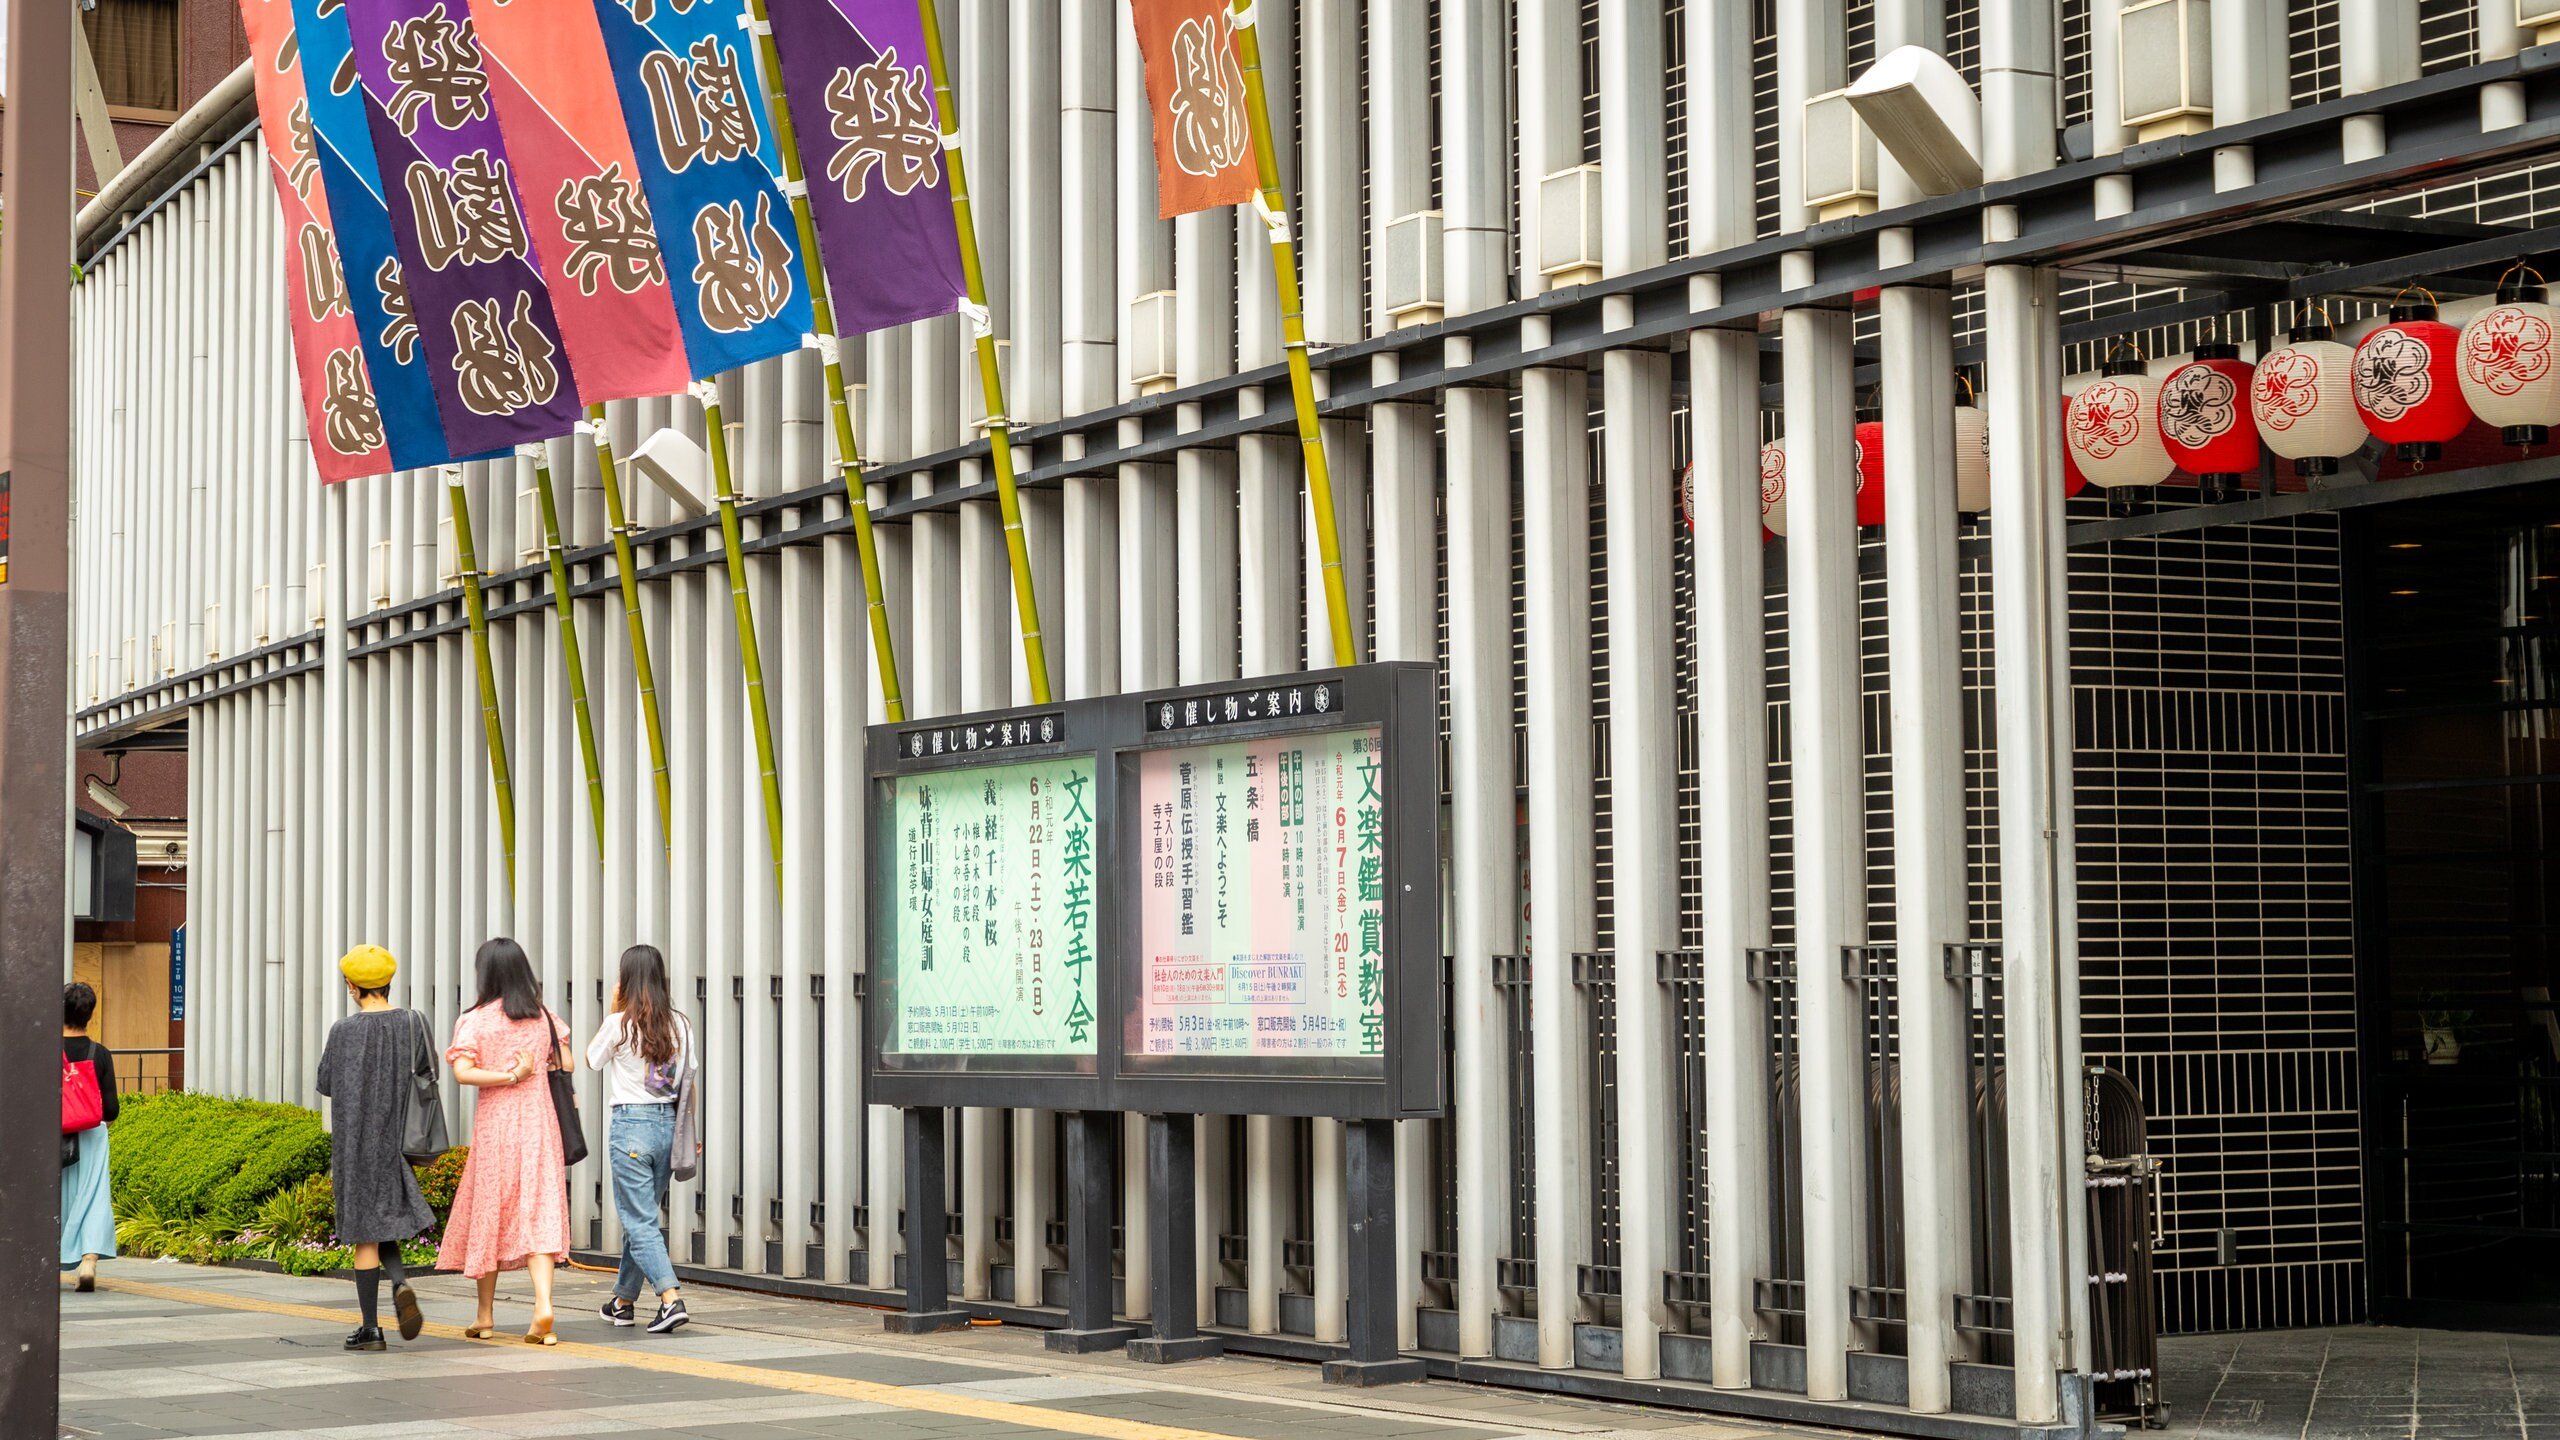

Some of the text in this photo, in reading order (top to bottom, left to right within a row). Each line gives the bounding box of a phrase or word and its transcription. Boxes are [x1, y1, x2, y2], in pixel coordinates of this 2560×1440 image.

[931, 719, 1032, 755] 催し物ご案内
[1184, 690, 1303, 726] 催し物ご案内
[1043, 777, 1054, 845] 令和元年
[1245, 754, 1259, 843] 五条橋
[918, 784, 934, 973] 妹背山婦女庭訓
[953, 824, 961, 923] すしやの段
[983, 778, 998, 947] 義経千本桜
[1152, 803, 1163, 889] 寺子屋の段
[1164, 801, 1175, 889] 寺入りの段
[1179, 762, 1194, 936] 菅原伝授手習鑑
[1215, 792, 1228, 929] 文楽へようこそ
[962, 823, 971, 963] 小金吾討死の段
[1062, 769, 1095, 1044] 文楽若手会
[1356, 756, 1385, 1055] 文楽鑑賞教室
[174, 985, 183, 993] 10
[1154, 967, 1224, 982] 社会人のための文楽入門
[1231, 965, 1304, 979] Discover BUNRAKU
[1149, 1017, 1173, 1032] 予約開始
[1257, 1016, 1296, 1031] 窓口販売開始
